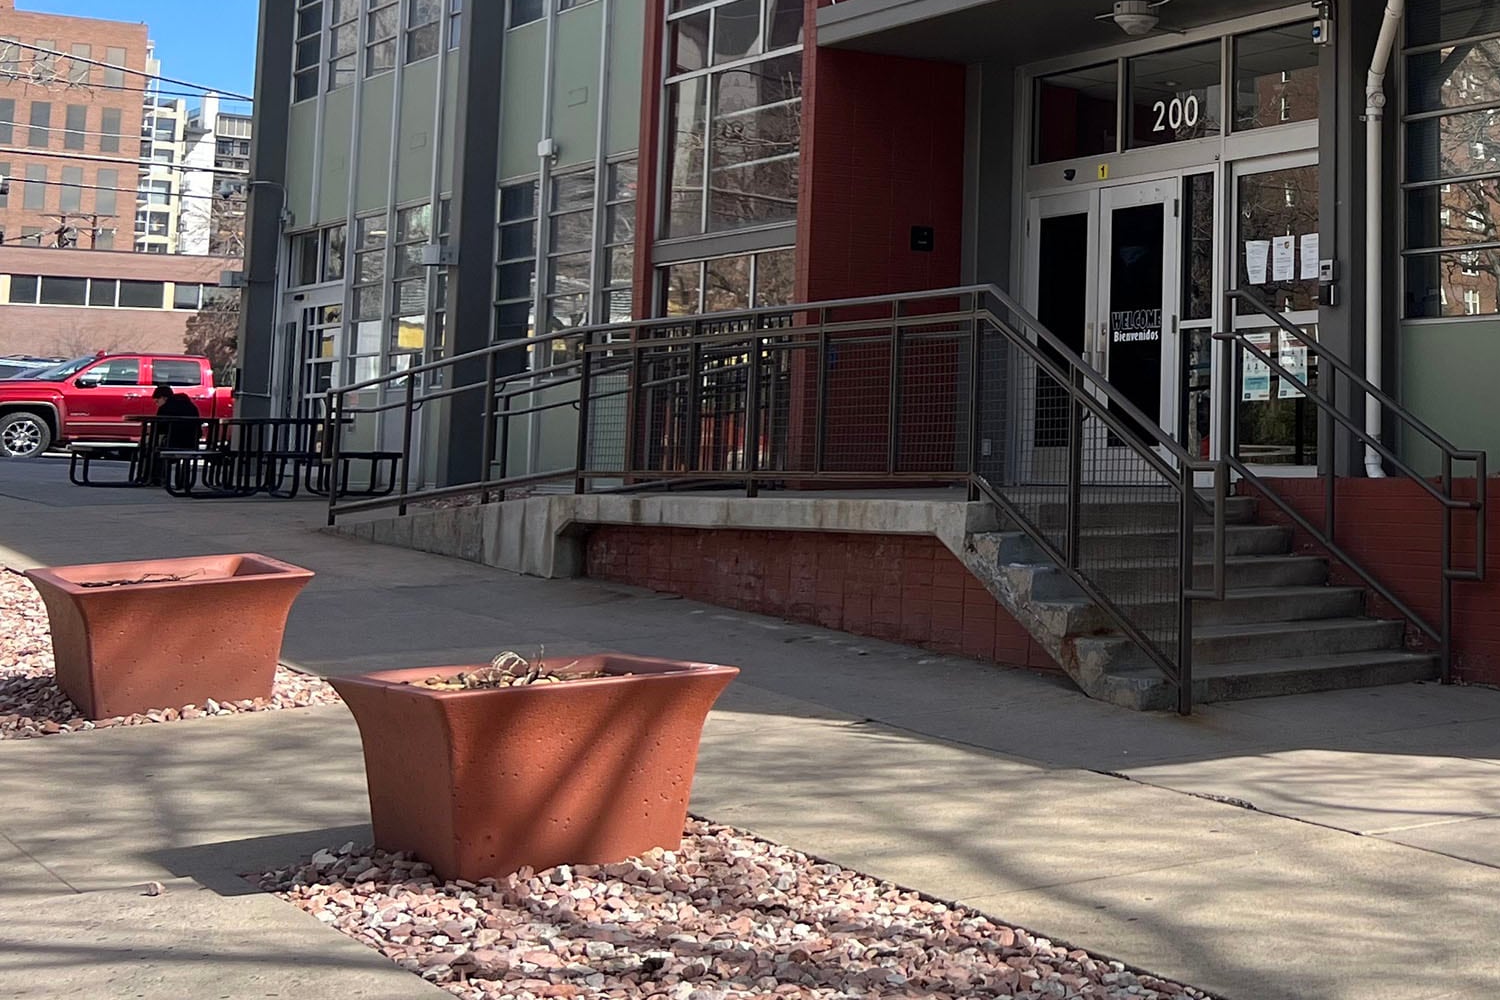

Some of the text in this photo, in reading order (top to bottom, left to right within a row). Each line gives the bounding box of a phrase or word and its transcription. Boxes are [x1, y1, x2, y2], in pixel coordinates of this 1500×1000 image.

[1152, 95, 1199, 132] 200
[1100, 165, 1106, 178] 1
[1111, 309, 1161, 330] WELCOME
[1113, 329, 1159, 342] Bienvenidos
